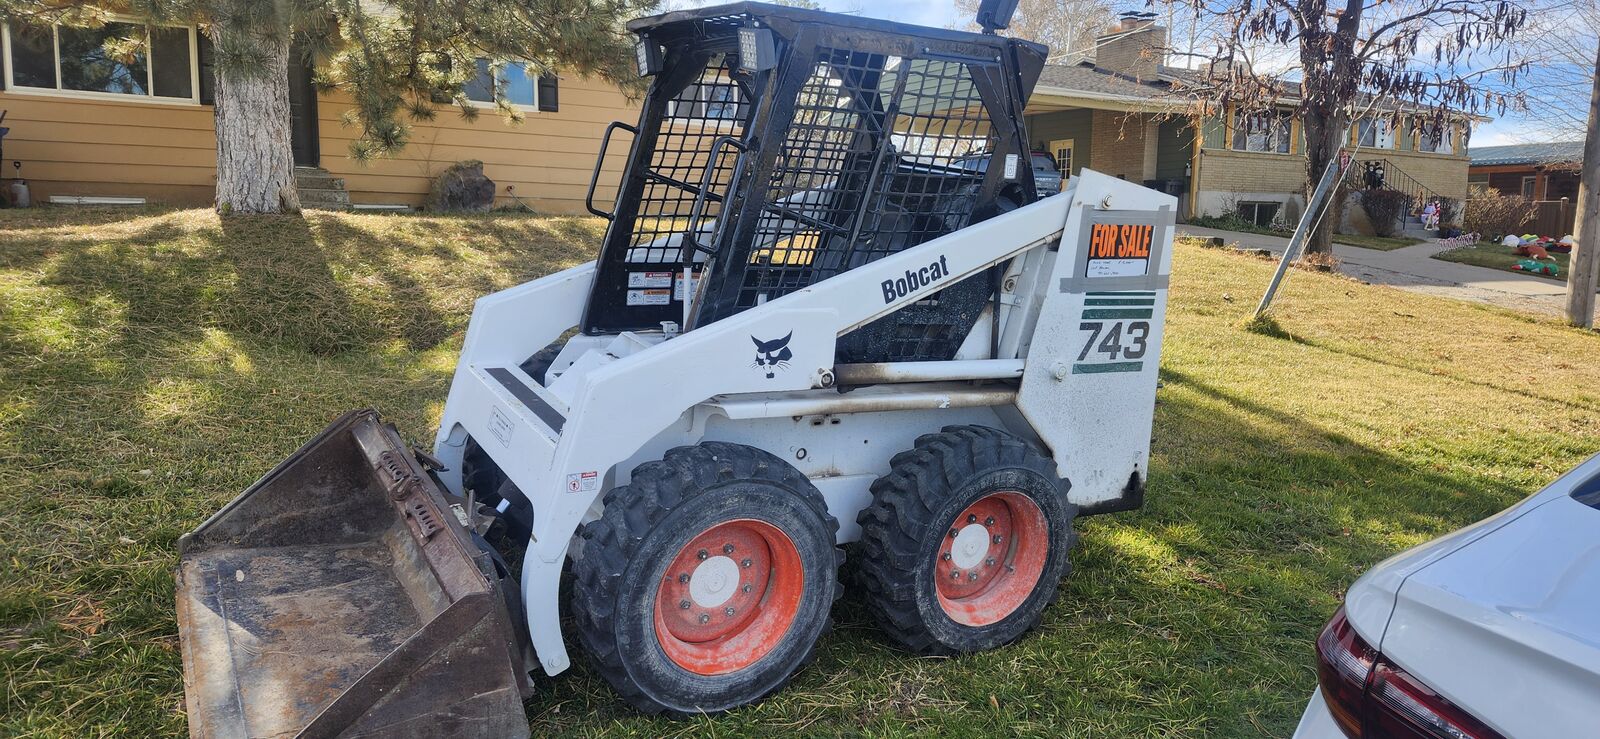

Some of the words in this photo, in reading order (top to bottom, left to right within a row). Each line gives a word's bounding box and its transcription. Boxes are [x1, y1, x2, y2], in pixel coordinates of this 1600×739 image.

[1090, 223, 1119, 257] FOR
[1117, 223, 1152, 257] SALE
[880, 254, 949, 305] Bobcat
[1076, 321, 1150, 361] 743
